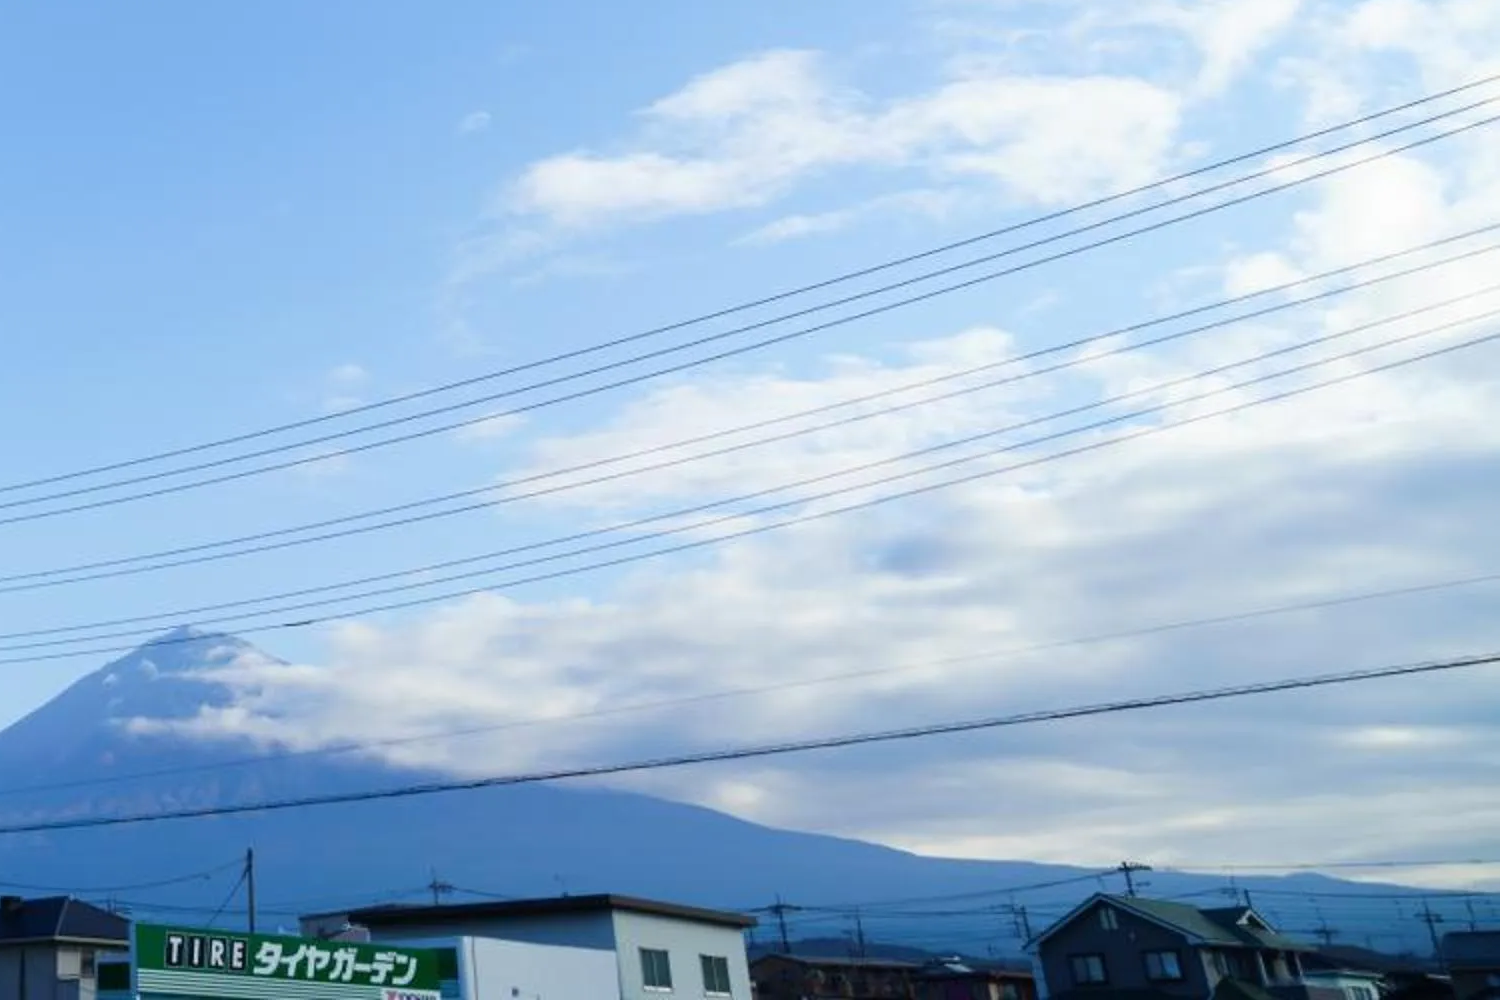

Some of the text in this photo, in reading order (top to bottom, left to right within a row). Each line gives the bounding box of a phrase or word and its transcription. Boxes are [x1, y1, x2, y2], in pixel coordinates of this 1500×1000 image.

[169, 937, 417, 985] TIRE タイヤガーデン
